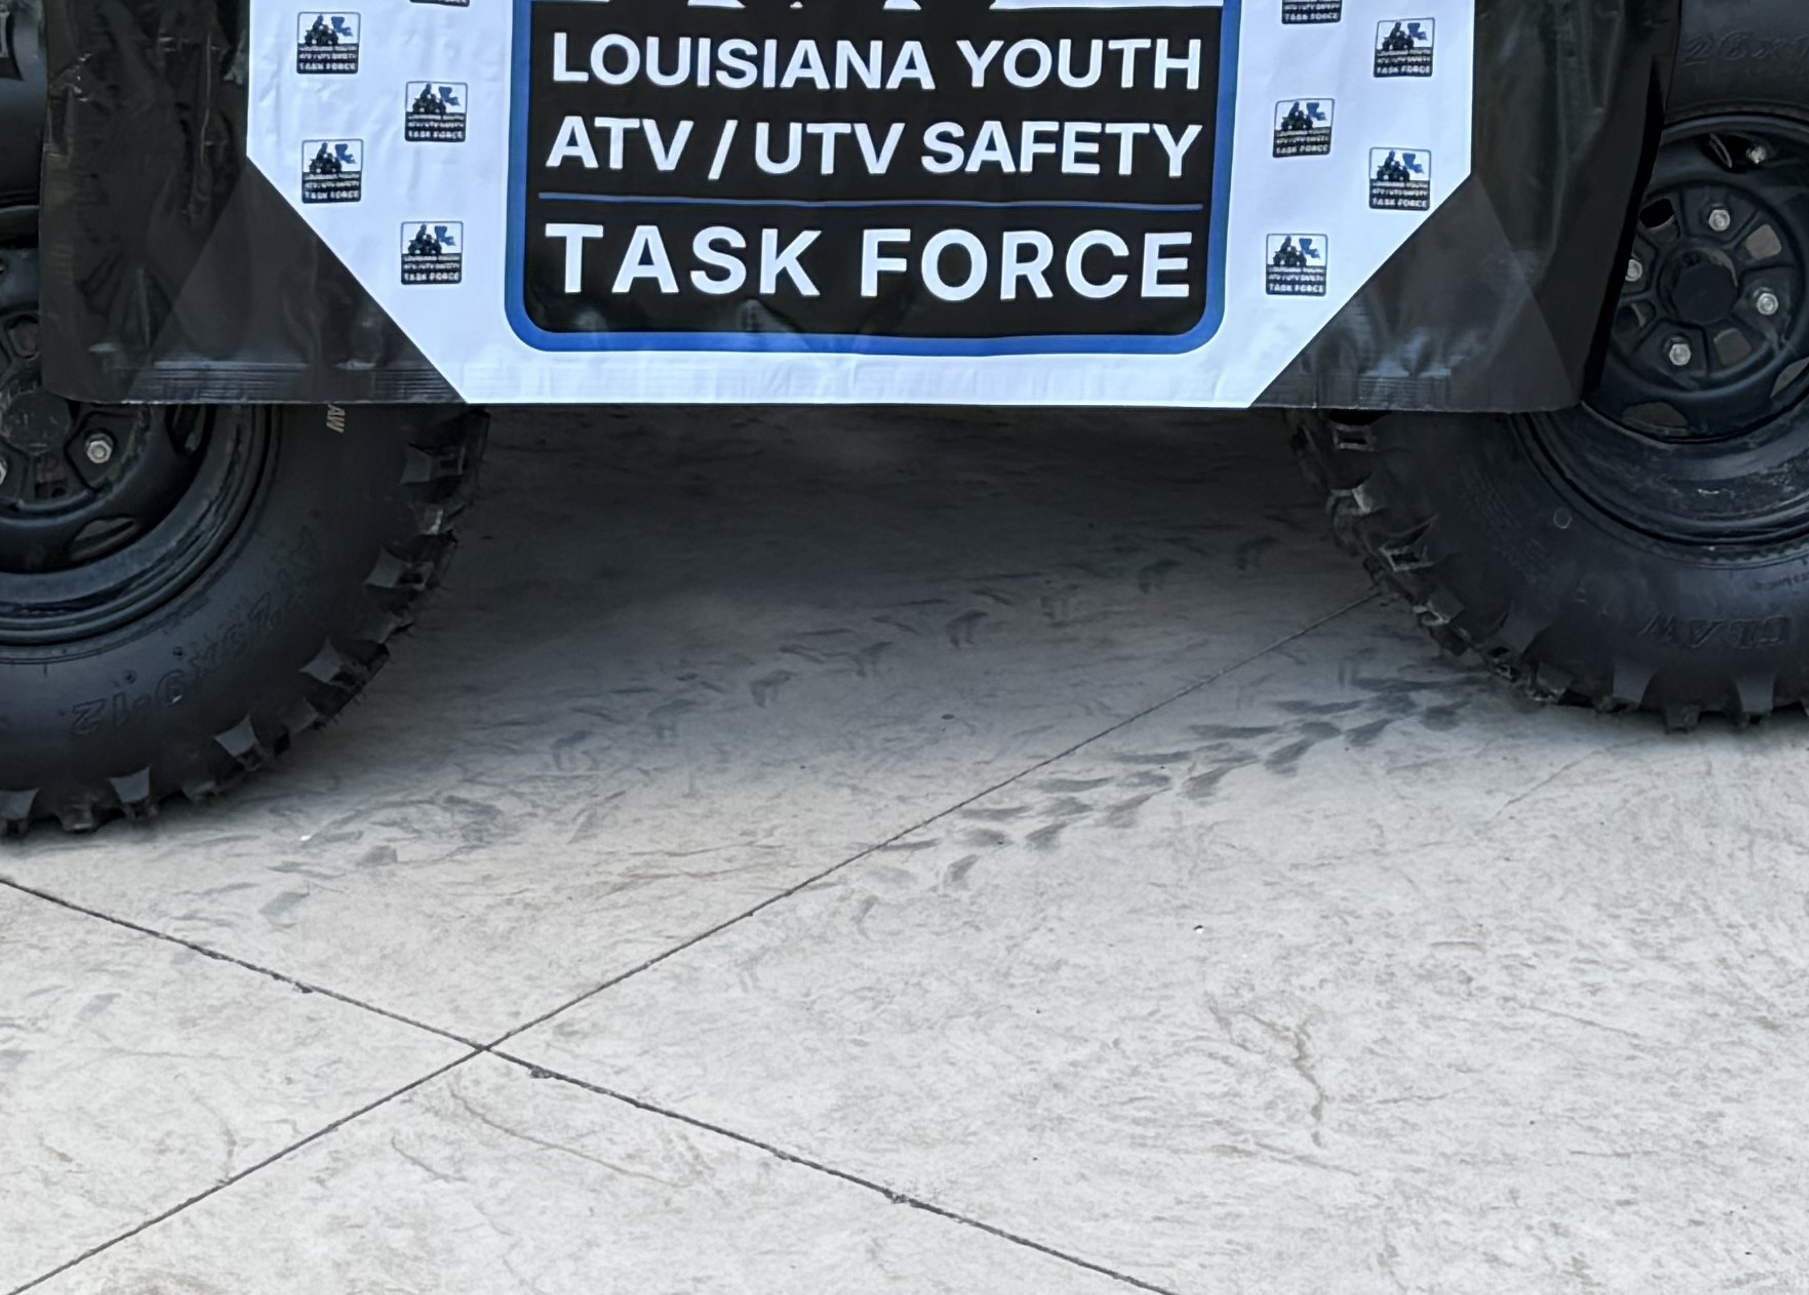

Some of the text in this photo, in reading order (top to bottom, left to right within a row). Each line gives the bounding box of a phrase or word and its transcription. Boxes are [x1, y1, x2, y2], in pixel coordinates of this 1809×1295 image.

[552, 32, 1203, 91] LOUISIANA YOUTH
[545, 115, 694, 171] ATV
[754, 121, 906, 176] UTV
[921, 120, 1203, 178] SAFETY
[545, 223, 1193, 302] TASK FORCE
[1638, 608, 1791, 650] CLAW
